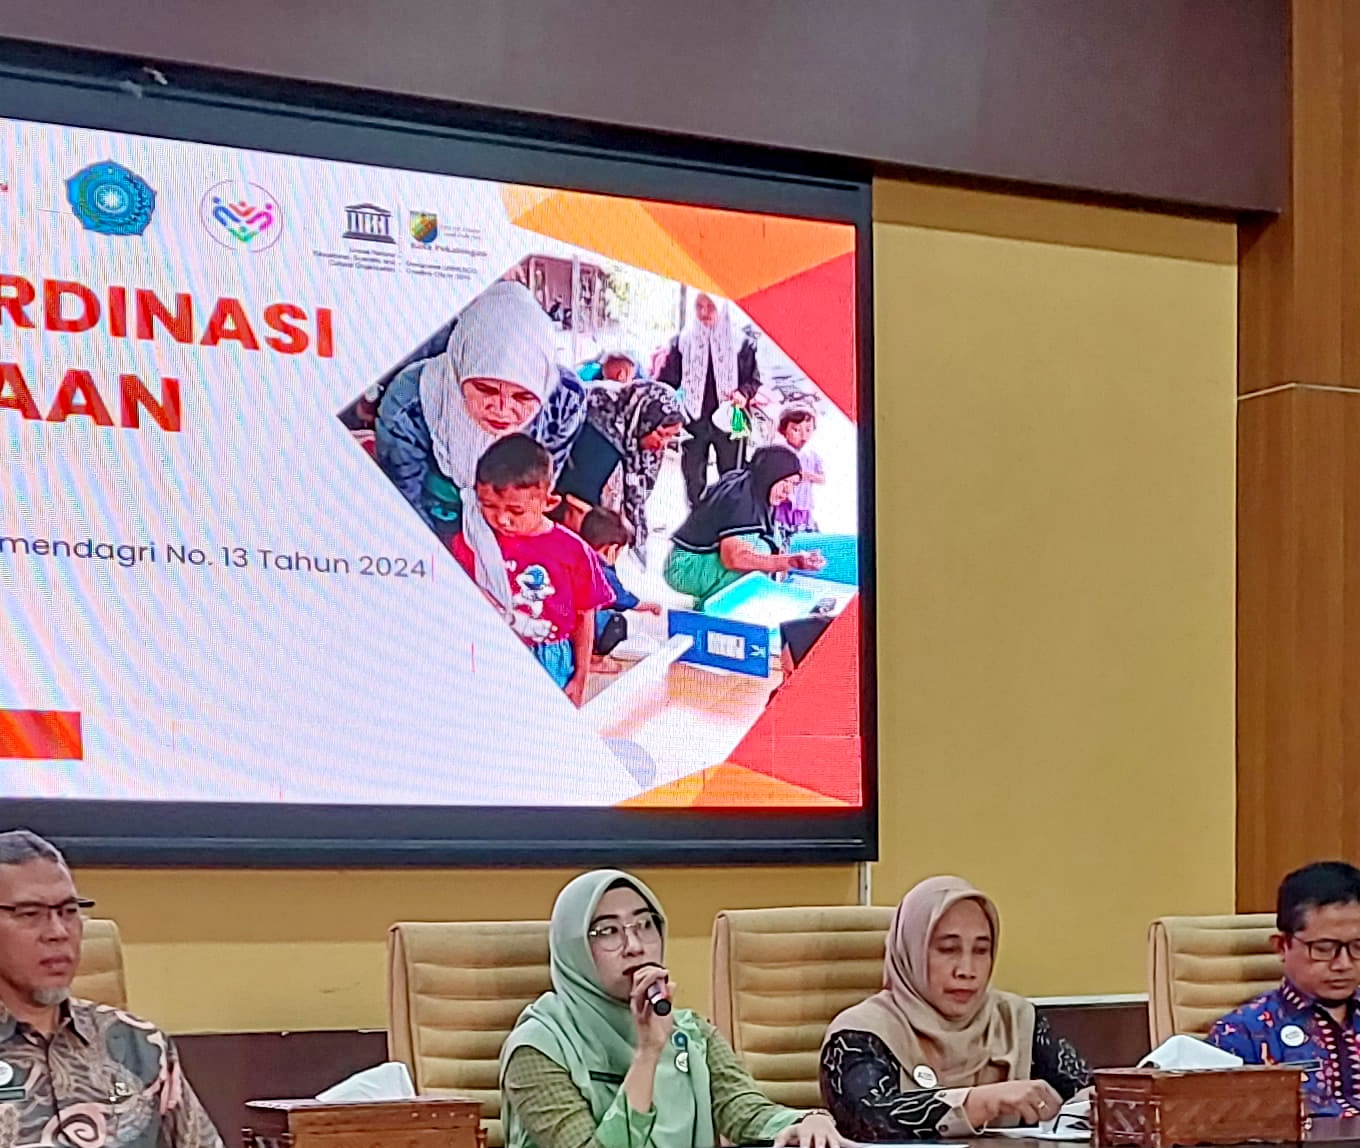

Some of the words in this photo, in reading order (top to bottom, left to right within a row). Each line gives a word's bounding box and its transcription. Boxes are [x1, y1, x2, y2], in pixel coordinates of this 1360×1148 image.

[167, 543, 213, 566] No.
[221, 547, 248, 569] 13
[257, 549, 350, 575] Tahun
[359, 555, 427, 578] 2024
